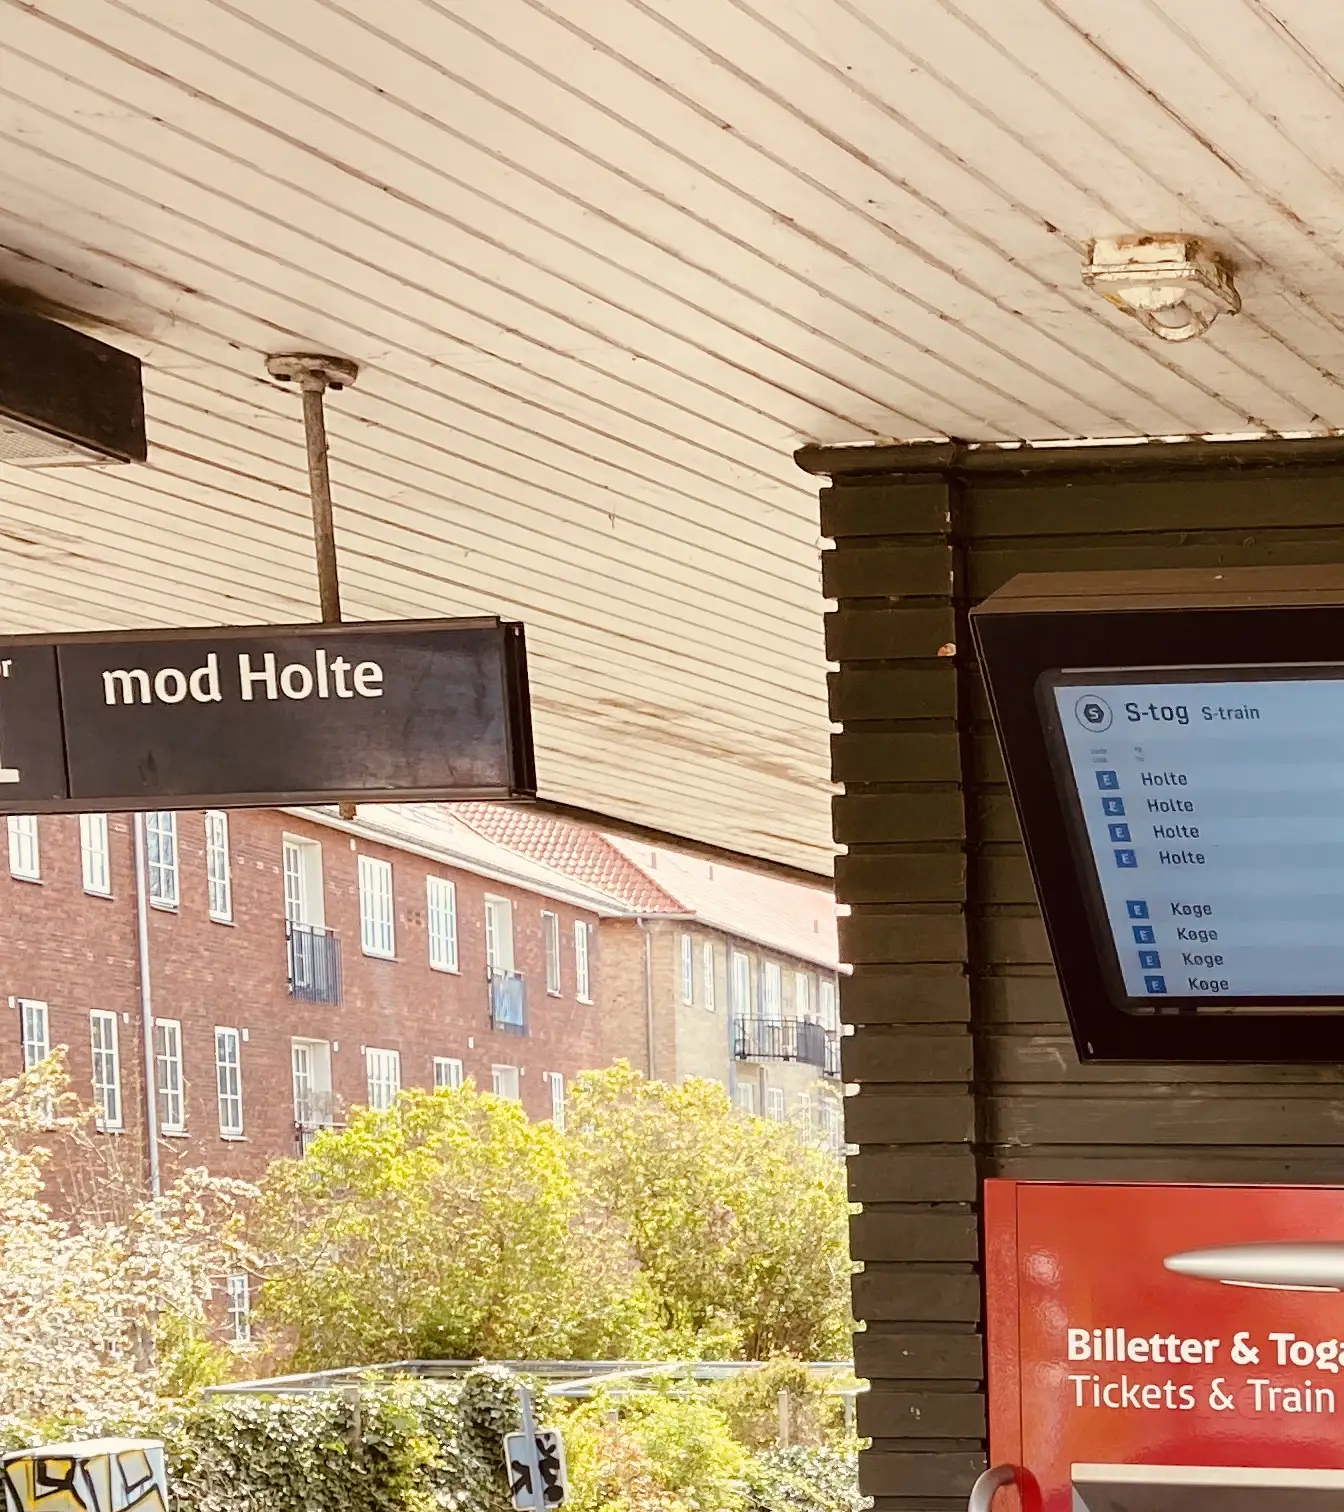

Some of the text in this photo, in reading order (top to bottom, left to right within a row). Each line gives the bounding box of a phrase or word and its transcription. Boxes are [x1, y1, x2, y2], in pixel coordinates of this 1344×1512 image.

[102, 649, 385, 705] mod Holte
[1124, 702, 1190, 725] S-tog
[1201, 704, 1261, 721] S-train
[1141, 772, 1188, 786] Holte
[1147, 798, 1194, 813] Holte
[1153, 825, 1200, 839] Holte
[1158, 850, 1206, 864] Holte
[1066, 1327, 1221, 1365] Billetter
[1230, 1332, 1260, 1365] &
[1068, 1374, 1195, 1411] Tickets
[1208, 1377, 1235, 1411] &
[1246, 1378, 1335, 1414] Train
